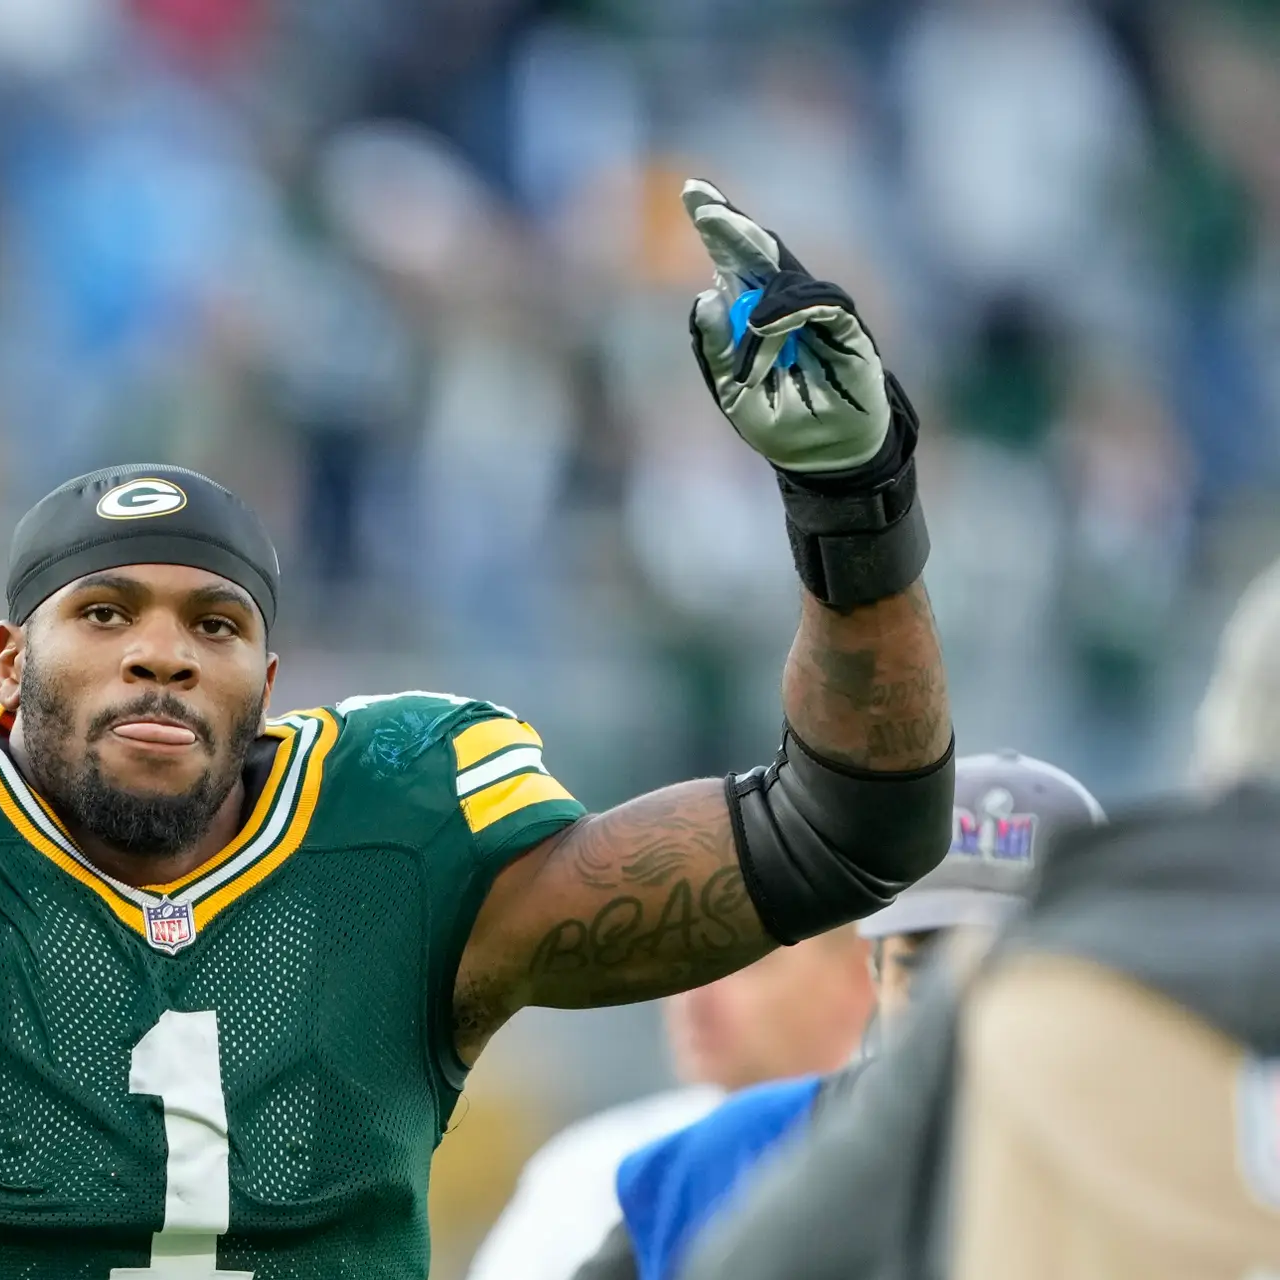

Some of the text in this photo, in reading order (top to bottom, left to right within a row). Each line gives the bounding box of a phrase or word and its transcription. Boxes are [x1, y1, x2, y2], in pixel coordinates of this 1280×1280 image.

[98, 479, 183, 517] G
[152, 919, 188, 943] NFL
[529, 864, 742, 974] BEAS
